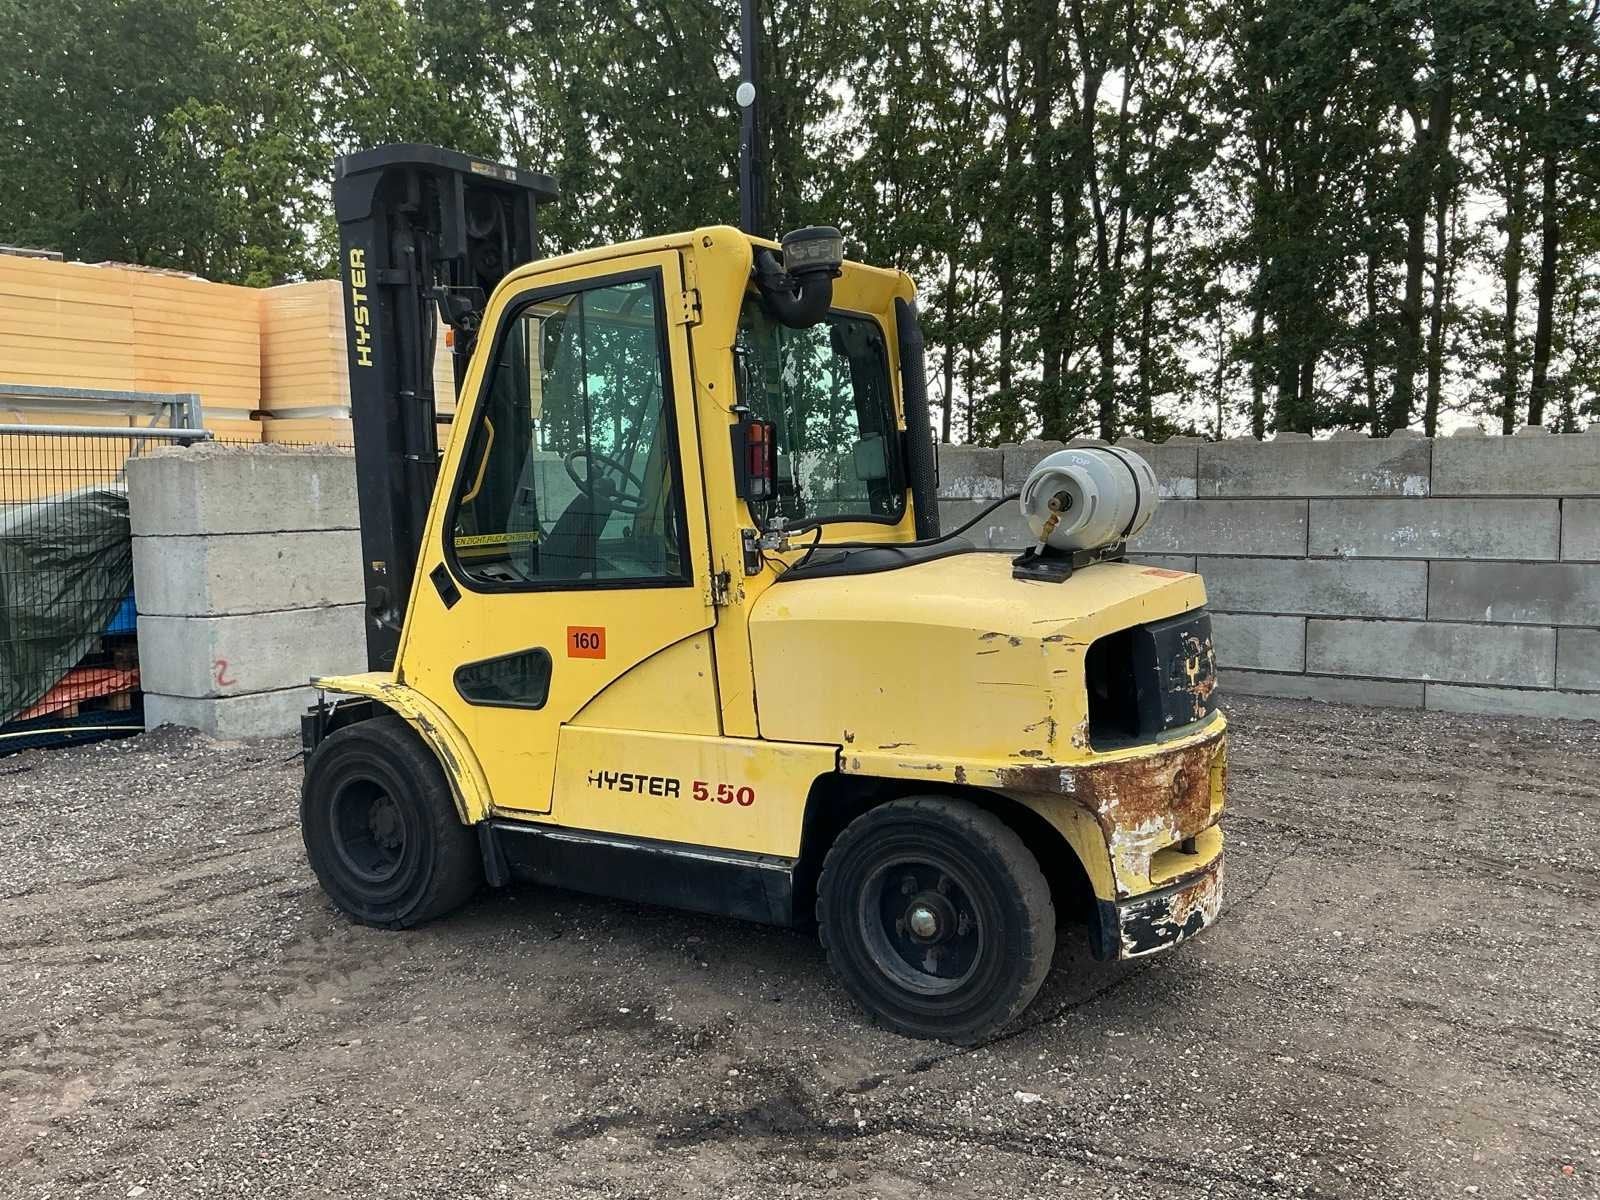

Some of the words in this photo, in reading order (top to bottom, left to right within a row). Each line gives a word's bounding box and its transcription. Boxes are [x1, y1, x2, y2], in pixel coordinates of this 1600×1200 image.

[350, 248, 373, 367] HYSTER
[573, 632, 600, 650] 160
[215, 660, 237, 686] 2
[587, 769, 681, 799] HYSTER
[692, 780, 756, 807] 5.50
